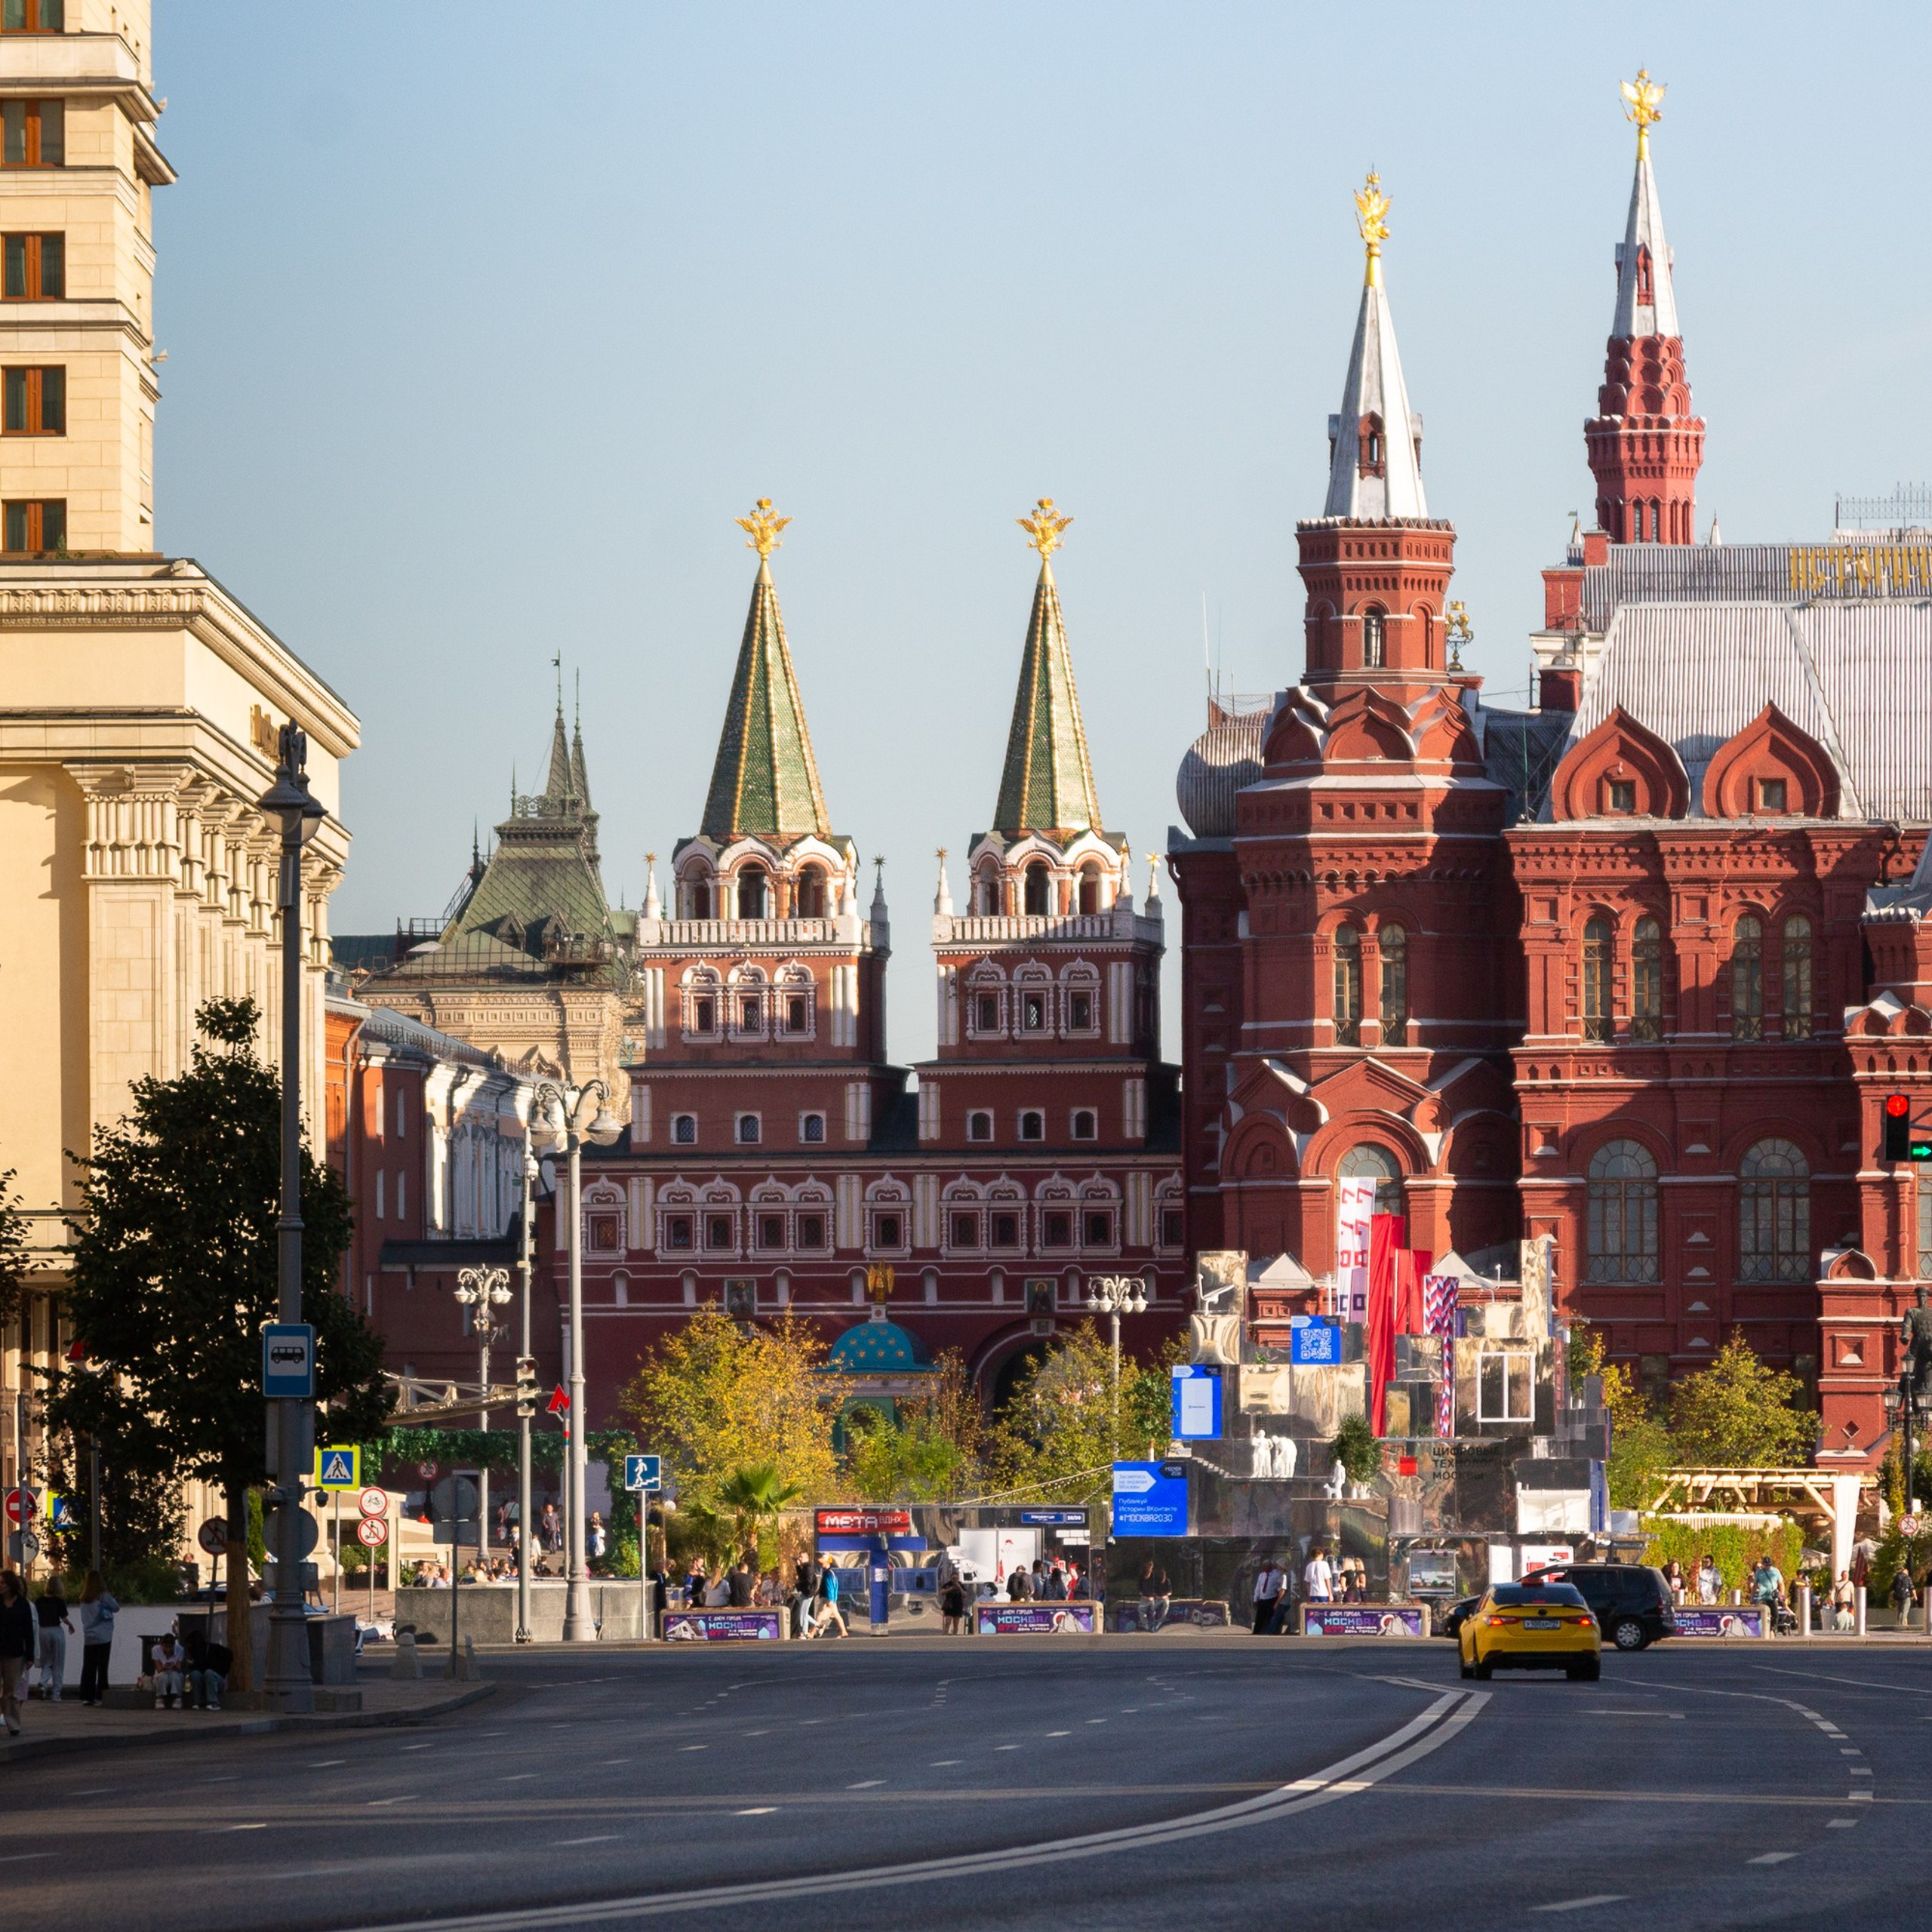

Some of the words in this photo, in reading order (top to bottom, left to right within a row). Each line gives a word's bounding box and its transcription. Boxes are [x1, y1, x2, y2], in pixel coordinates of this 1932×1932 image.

[1791, 547, 1932, 590] ИСТОРИЧ
[1433, 1447, 1499, 1456] ЦИФРОВЫЕ
[879, 1515, 903, 1524] ВДНХ
[1119, 1514, 1173, 1522] #МОСКВА2030
